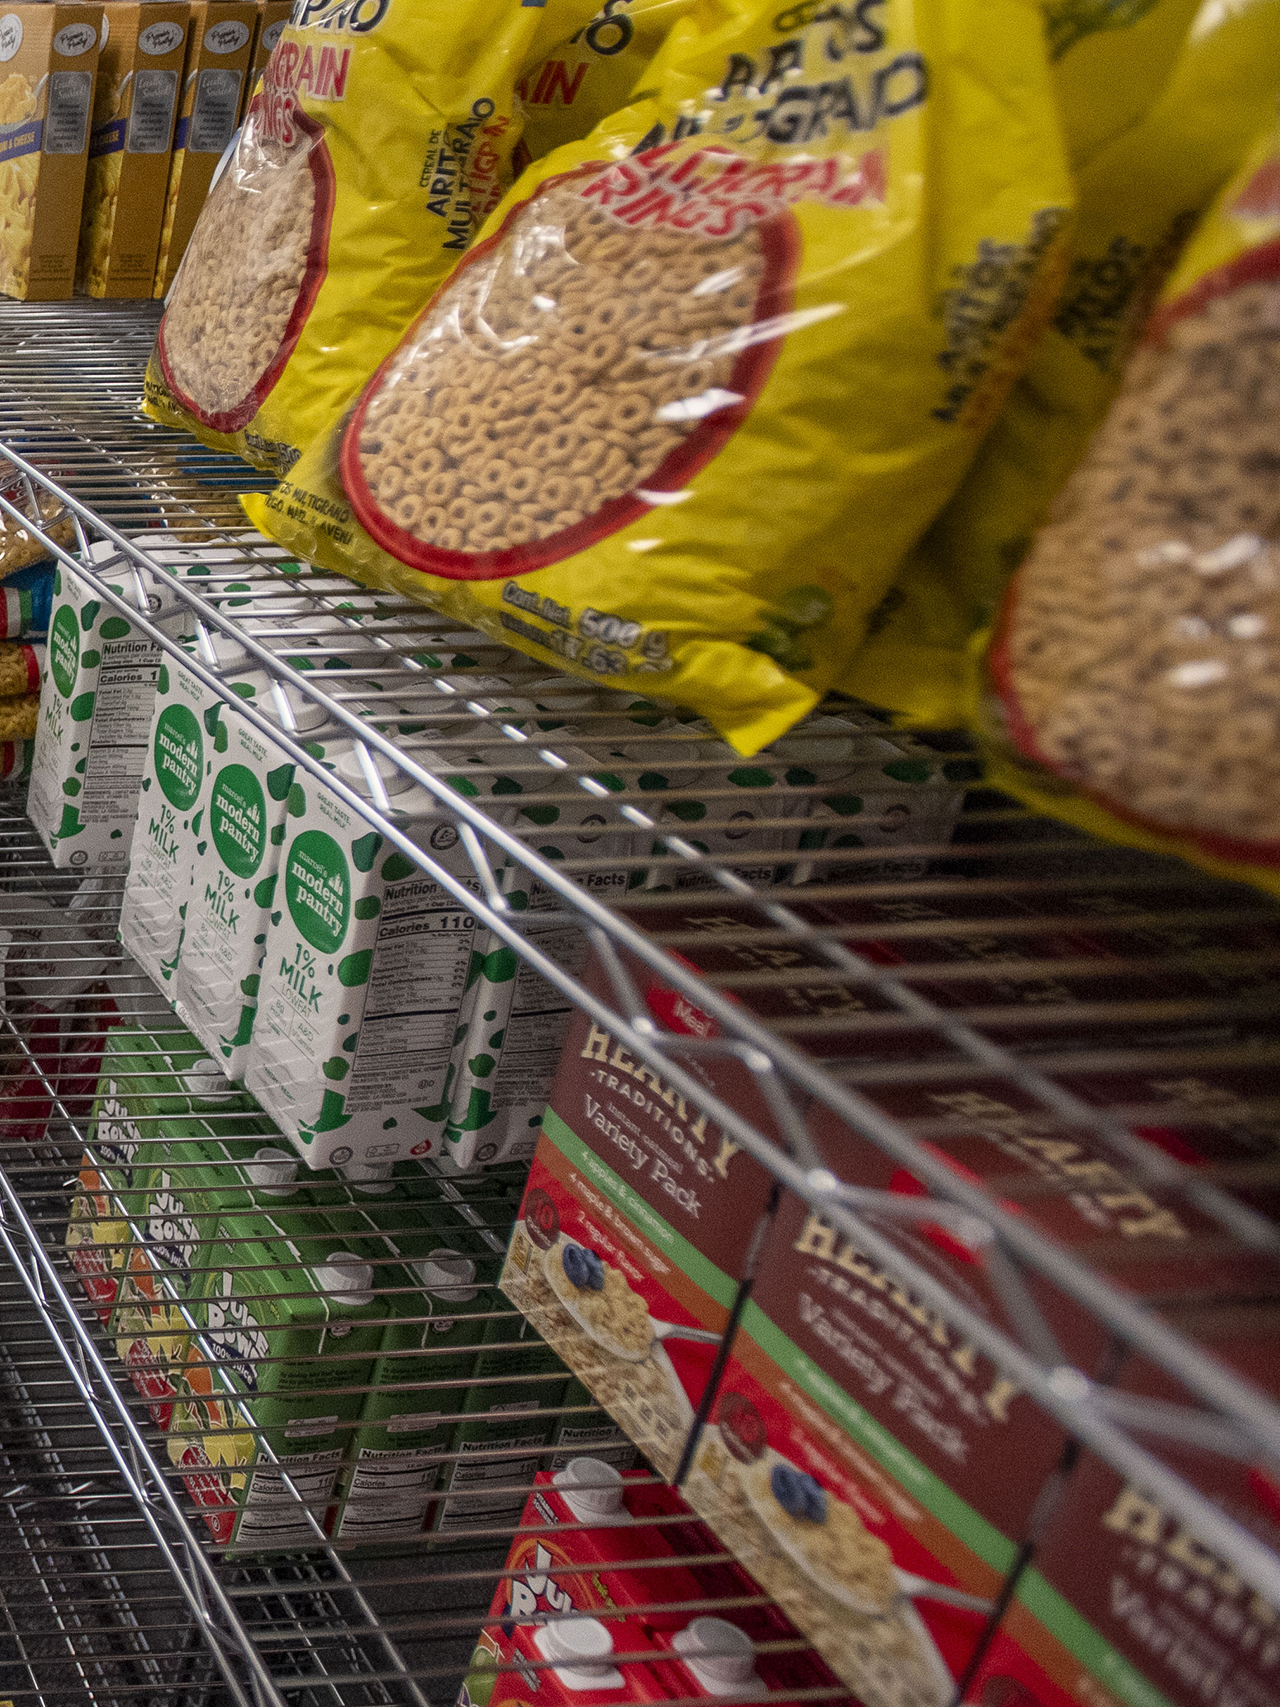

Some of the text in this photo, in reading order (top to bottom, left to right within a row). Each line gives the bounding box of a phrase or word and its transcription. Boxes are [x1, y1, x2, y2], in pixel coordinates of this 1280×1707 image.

[429, 128, 442, 144] DE
[103, 642, 148, 655] Nutrition
[100, 674, 143, 684] Calories
[238, 728, 254, 744] GREAT
[159, 732, 199, 778] modern
[163, 753, 197, 797] pantry
[317, 792, 335, 810] GREAT
[320, 803, 334, 820] REAL
[160, 804, 176, 834] 1%
[215, 794, 261, 844] modern
[148, 818, 180, 865] MILK
[219, 815, 261, 864] pantry
[298, 850, 328, 878] marcel's
[218, 870, 236, 903] 1%
[291, 861, 344, 917] modern
[384, 882, 438, 901] Nutrition
[586, 872, 627, 887] Facts
[205, 883, 241, 935] MILK
[296, 884, 343, 937] pantry
[379, 915, 476, 938] Calories 110
[294, 942, 318, 979] 1%
[279, 956, 324, 1015] MILK
[281, 983, 313, 1020] LOWFAT
[671, 1000, 714, 1037] Meal
[593, 1067, 712, 1180] TRADITIONS
[582, 1092, 703, 1220] Variety Pack
[534, 1201, 554, 1230] 10
[462, 1434, 545, 1452] Nutrition Facts
[562, 1428, 611, 1439] Nutrition
[259, 1453, 310, 1466] Nrition
[361, 1447, 413, 1460] Nutrition
[353, 1477, 387, 1488] Calories
